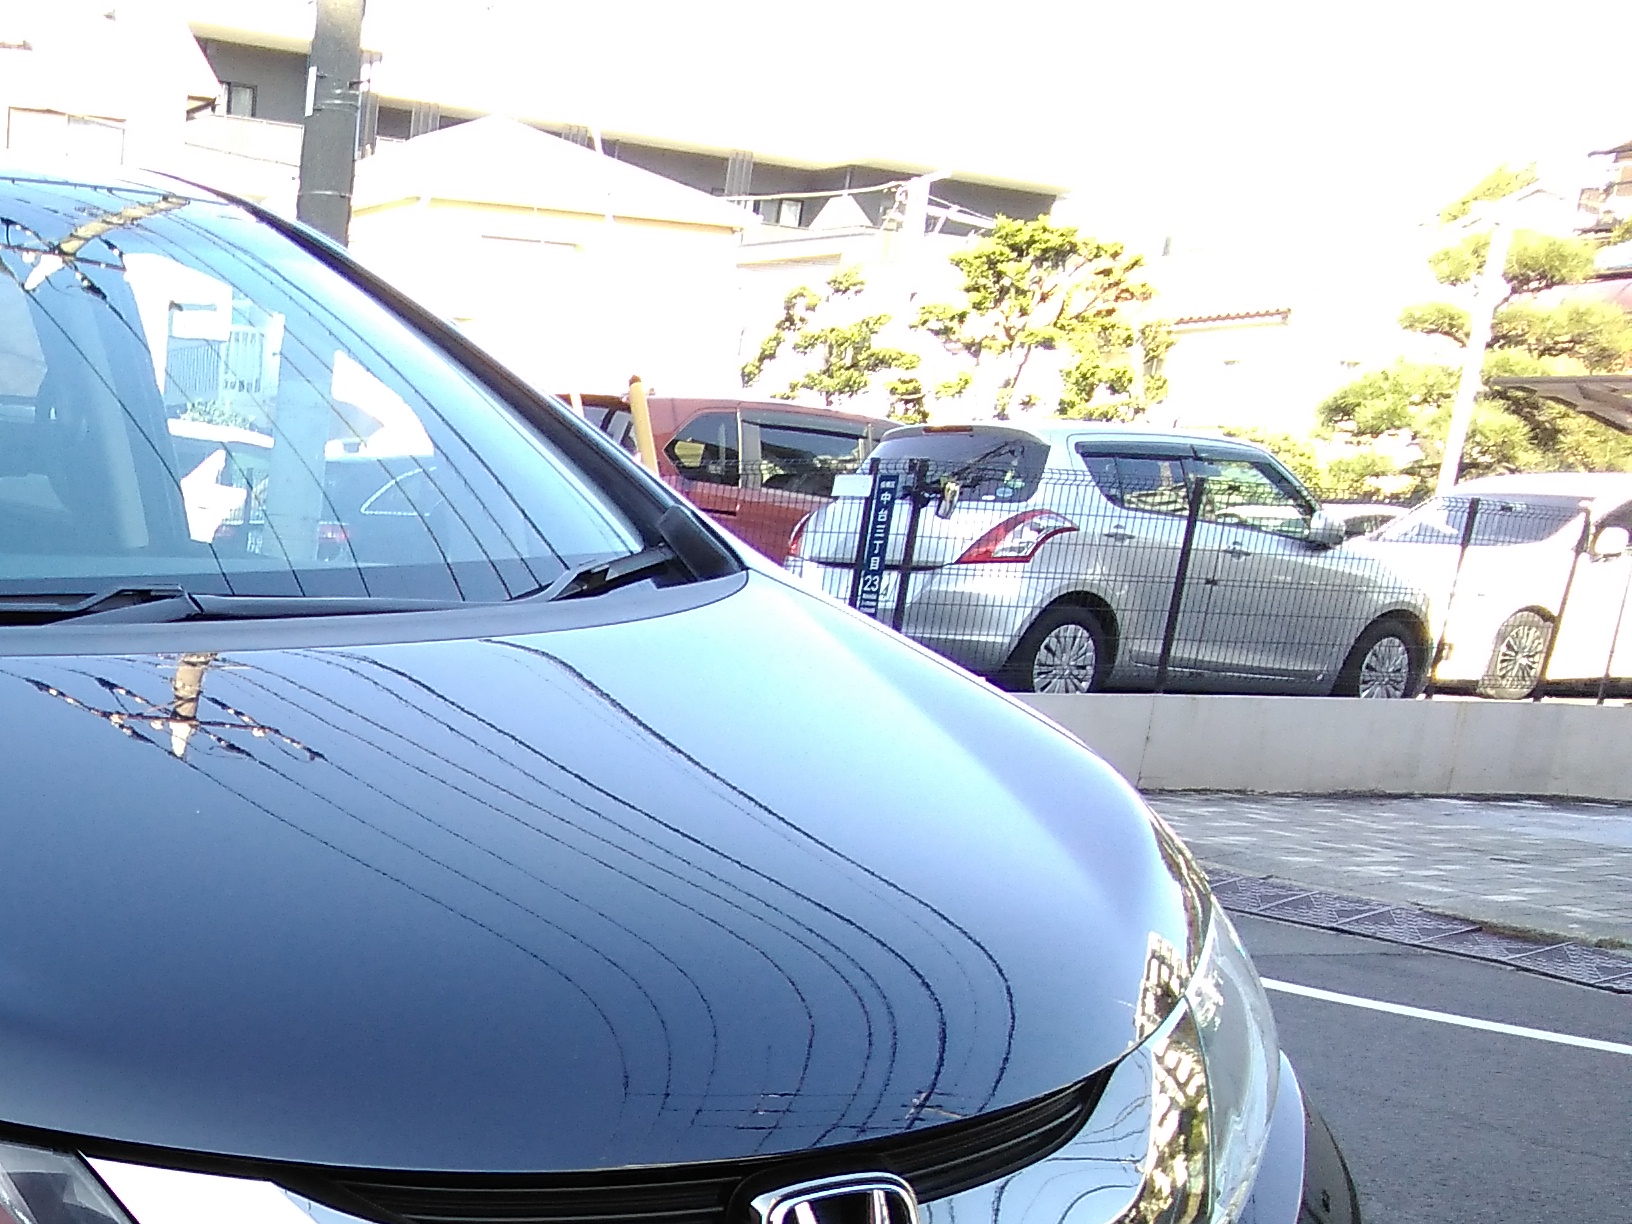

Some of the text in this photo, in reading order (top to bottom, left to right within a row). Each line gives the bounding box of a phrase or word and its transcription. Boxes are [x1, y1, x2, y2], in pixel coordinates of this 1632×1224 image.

[869, 491, 892, 570] 中台三丁目
[863, 574, 880, 592] 23
